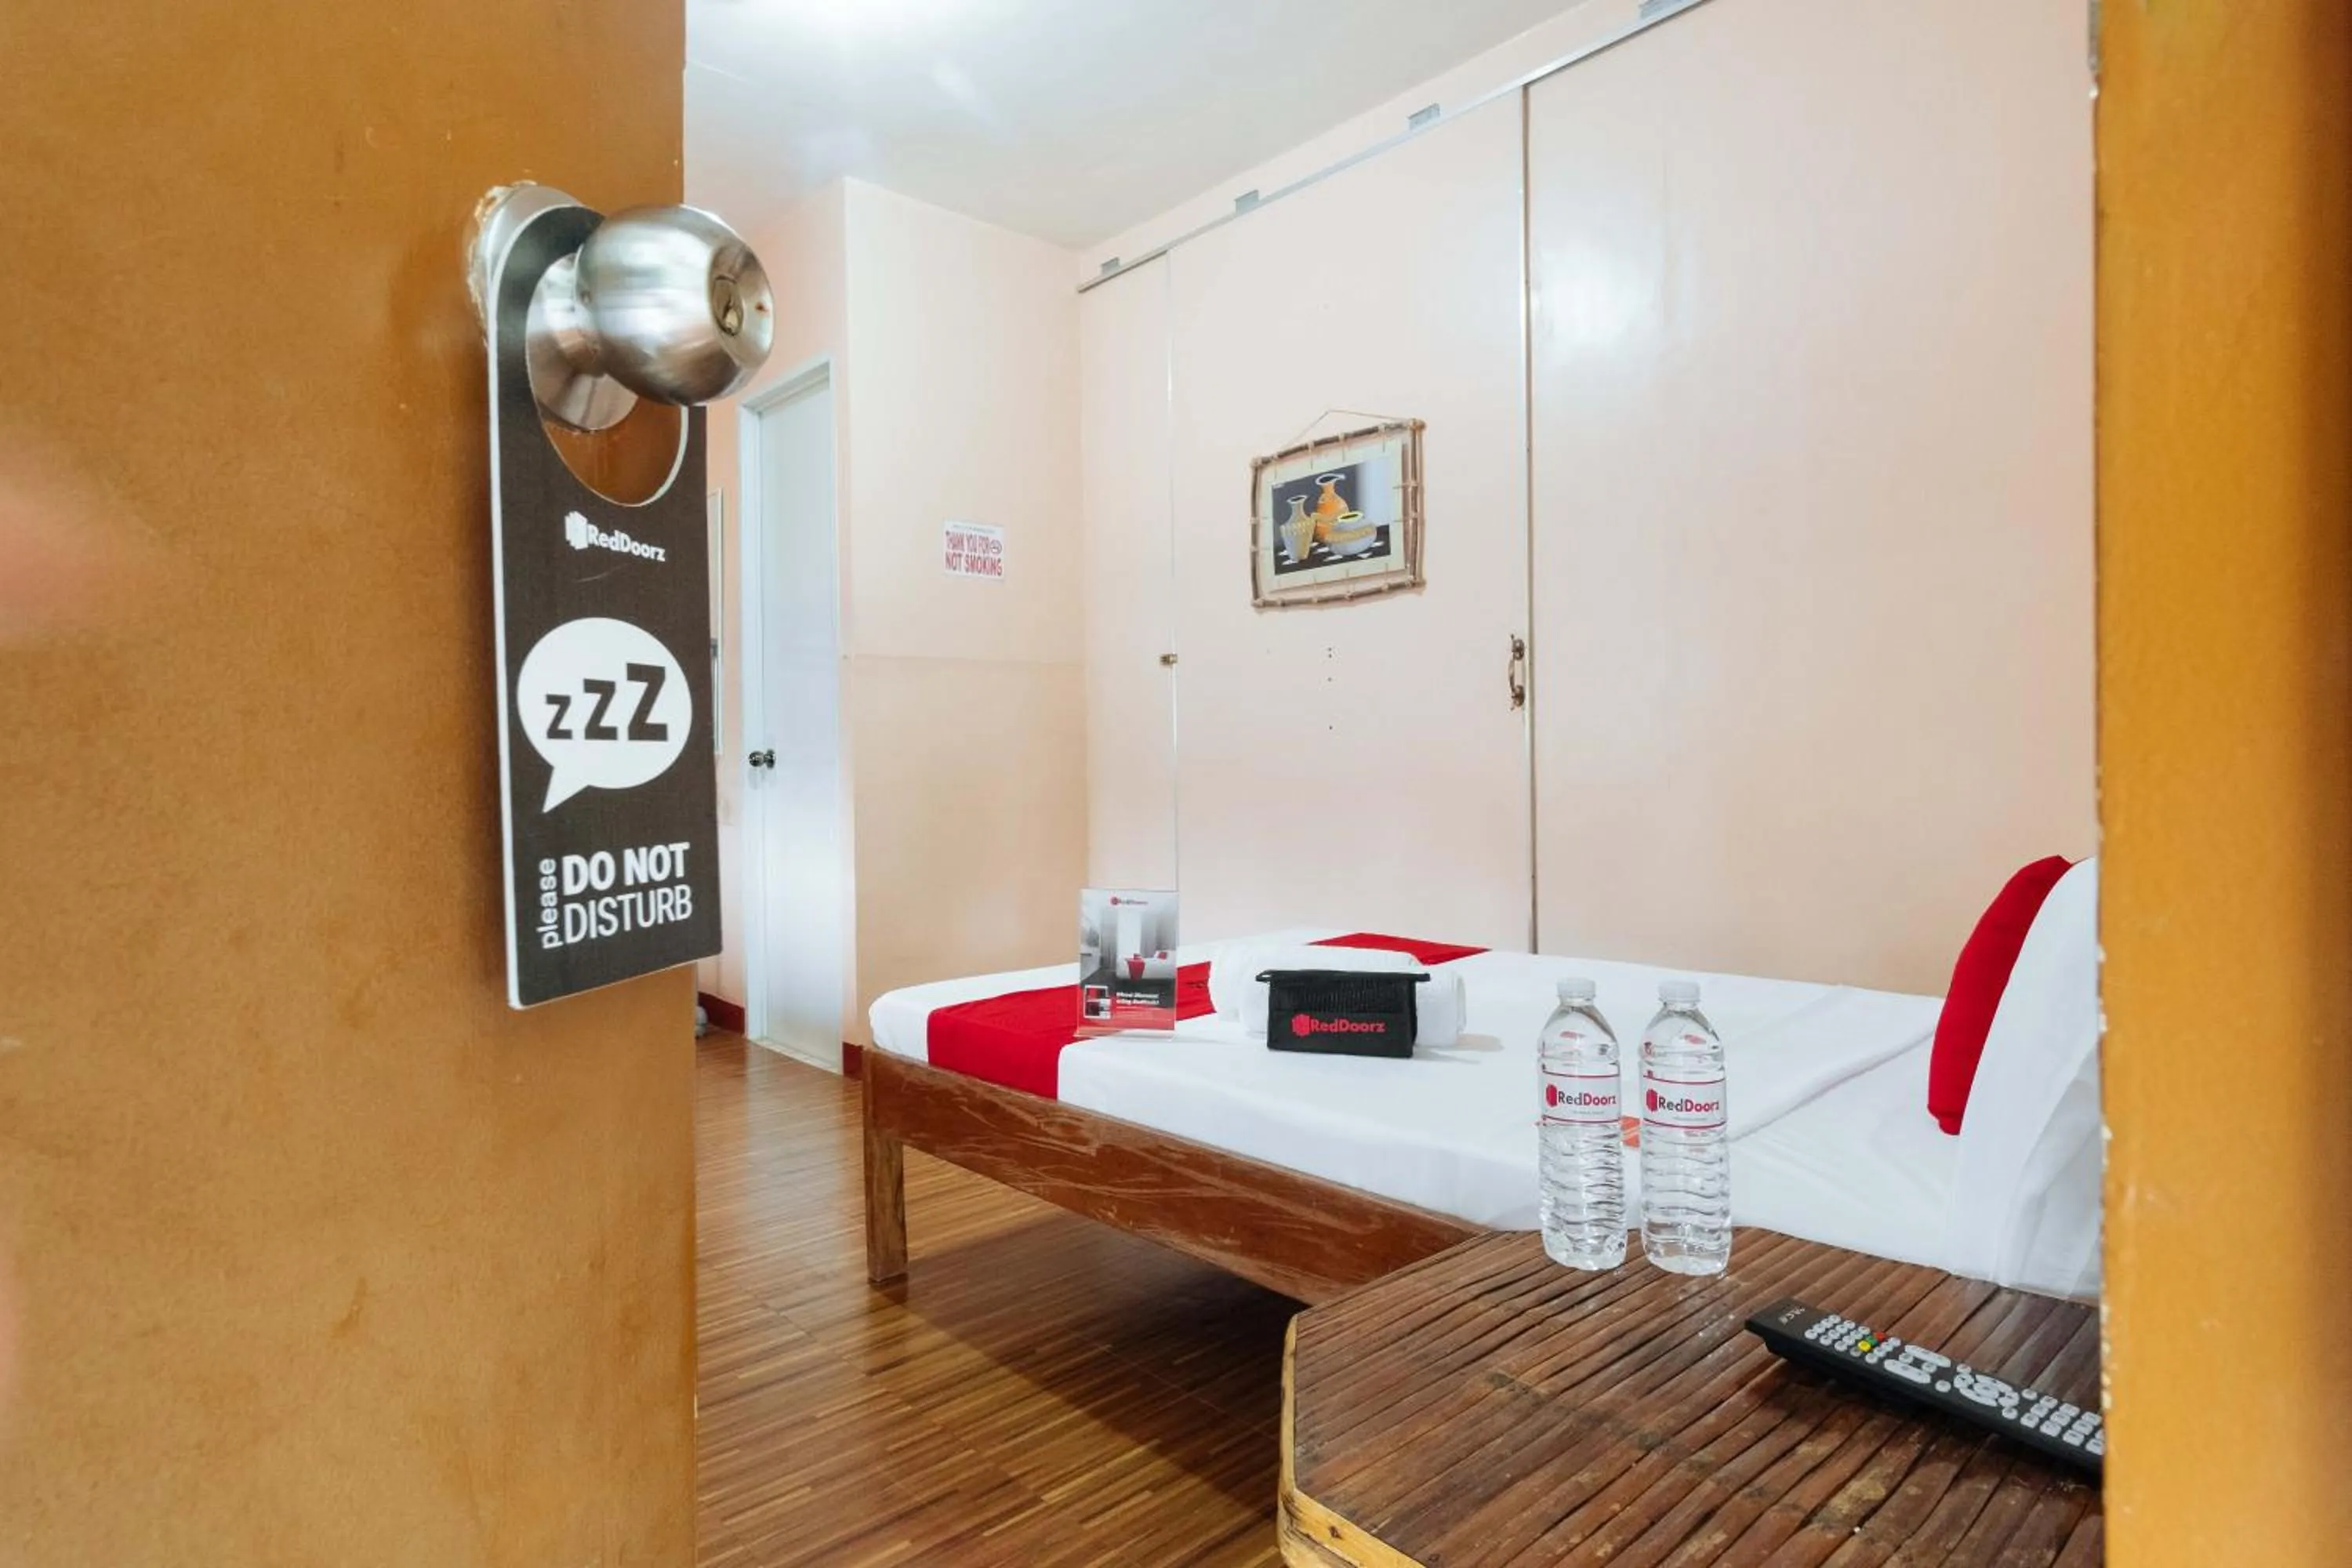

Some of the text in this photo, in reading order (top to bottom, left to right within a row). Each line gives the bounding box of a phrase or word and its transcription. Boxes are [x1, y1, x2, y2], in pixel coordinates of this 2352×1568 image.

[587, 523, 666, 562] RedDoorz
[946, 531, 990, 555] THANK YOU FOR
[946, 551, 1003, 576] NOT SMOKING
[562, 841, 690, 895] DO NOT
[536, 858, 564, 949] please
[564, 884, 693, 944] DISTURB
[1311, 1018, 1385, 1033] RedDoorz
